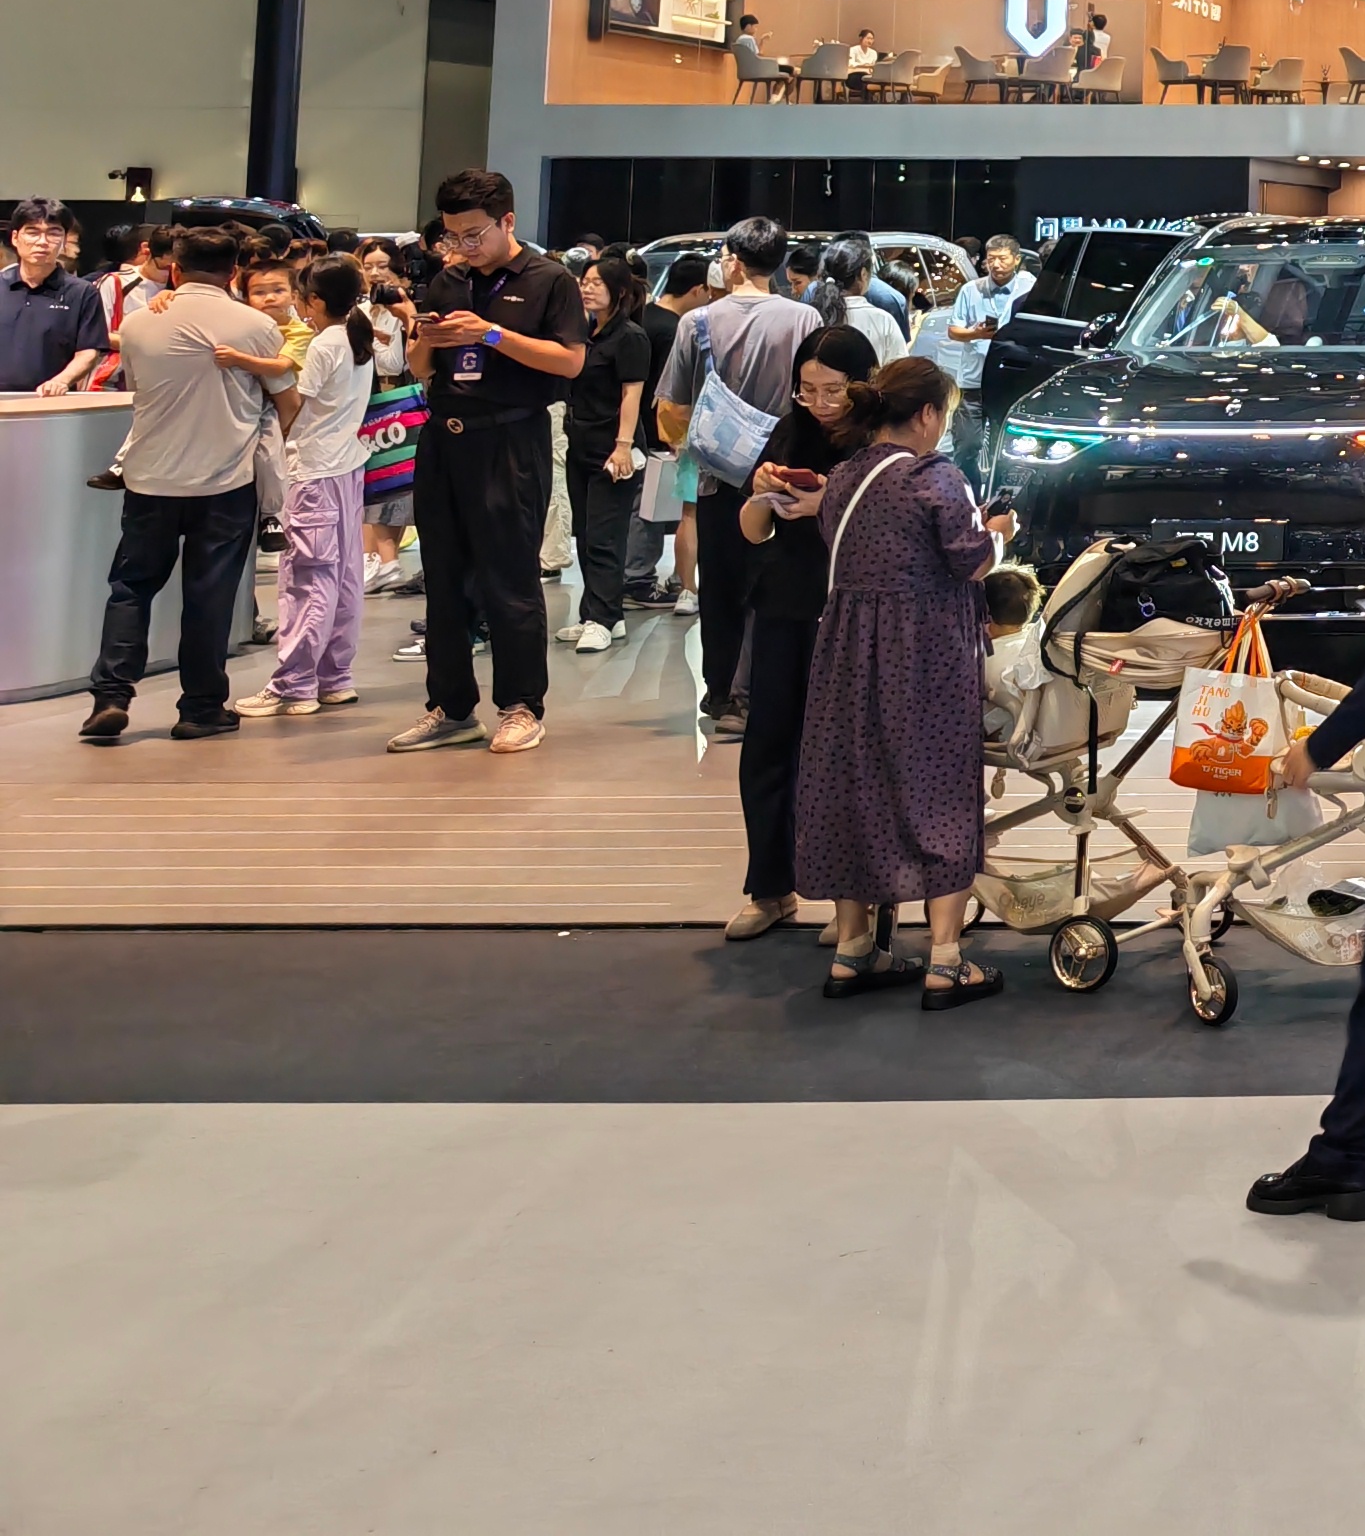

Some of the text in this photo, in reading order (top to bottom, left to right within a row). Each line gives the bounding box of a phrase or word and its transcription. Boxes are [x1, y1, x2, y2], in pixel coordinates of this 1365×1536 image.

[1222, 531, 1260, 552] M8
[1201, 685, 1231, 698] TANG
[1191, 705, 1211, 717] HU
